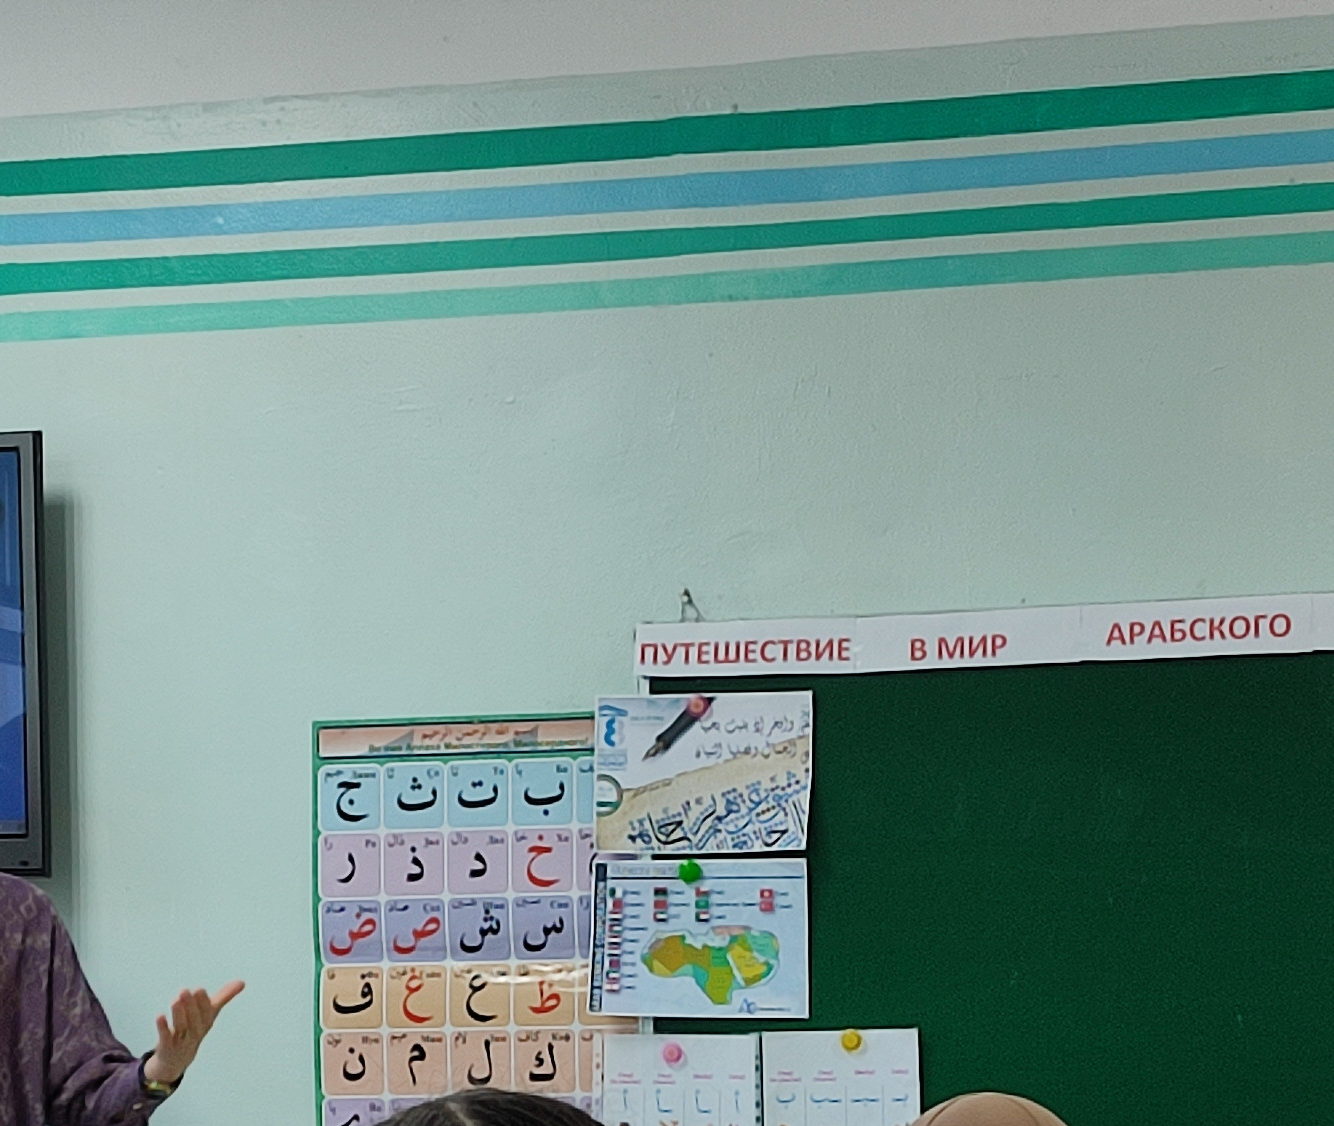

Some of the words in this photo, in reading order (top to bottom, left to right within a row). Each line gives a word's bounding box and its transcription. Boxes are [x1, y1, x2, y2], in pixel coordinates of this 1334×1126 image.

[639, 637, 852, 666] ПУТЕШЕСТВИЕ
[909, 637, 928, 662] В
[937, 633, 1008, 660] МИР
[1105, 612, 1292, 647] АРАБСКОГО
[336, 780, 370, 822] ج
[397, 776, 438, 812] ث
[457, 780, 499, 808] ت
[524, 780, 565, 816] ب
[336, 851, 357, 884] ر
[405, 846, 425, 882] ذ
[468, 851, 488, 879] د
[526, 833, 562, 888] خ
[329, 911, 377, 957] ض
[392, 916, 441, 954] ص
[459, 908, 501, 954] ش
[522, 915, 565, 952] س
[332, 972, 374, 1015] ف
[402, 967, 434, 1023] غ
[466, 973, 499, 1022] ع
[342, 1047, 366, 1082] ن
[408, 1043, 427, 1086] م
[467, 1038, 493, 1086] ل
[528, 1041, 557, 1082] ك
